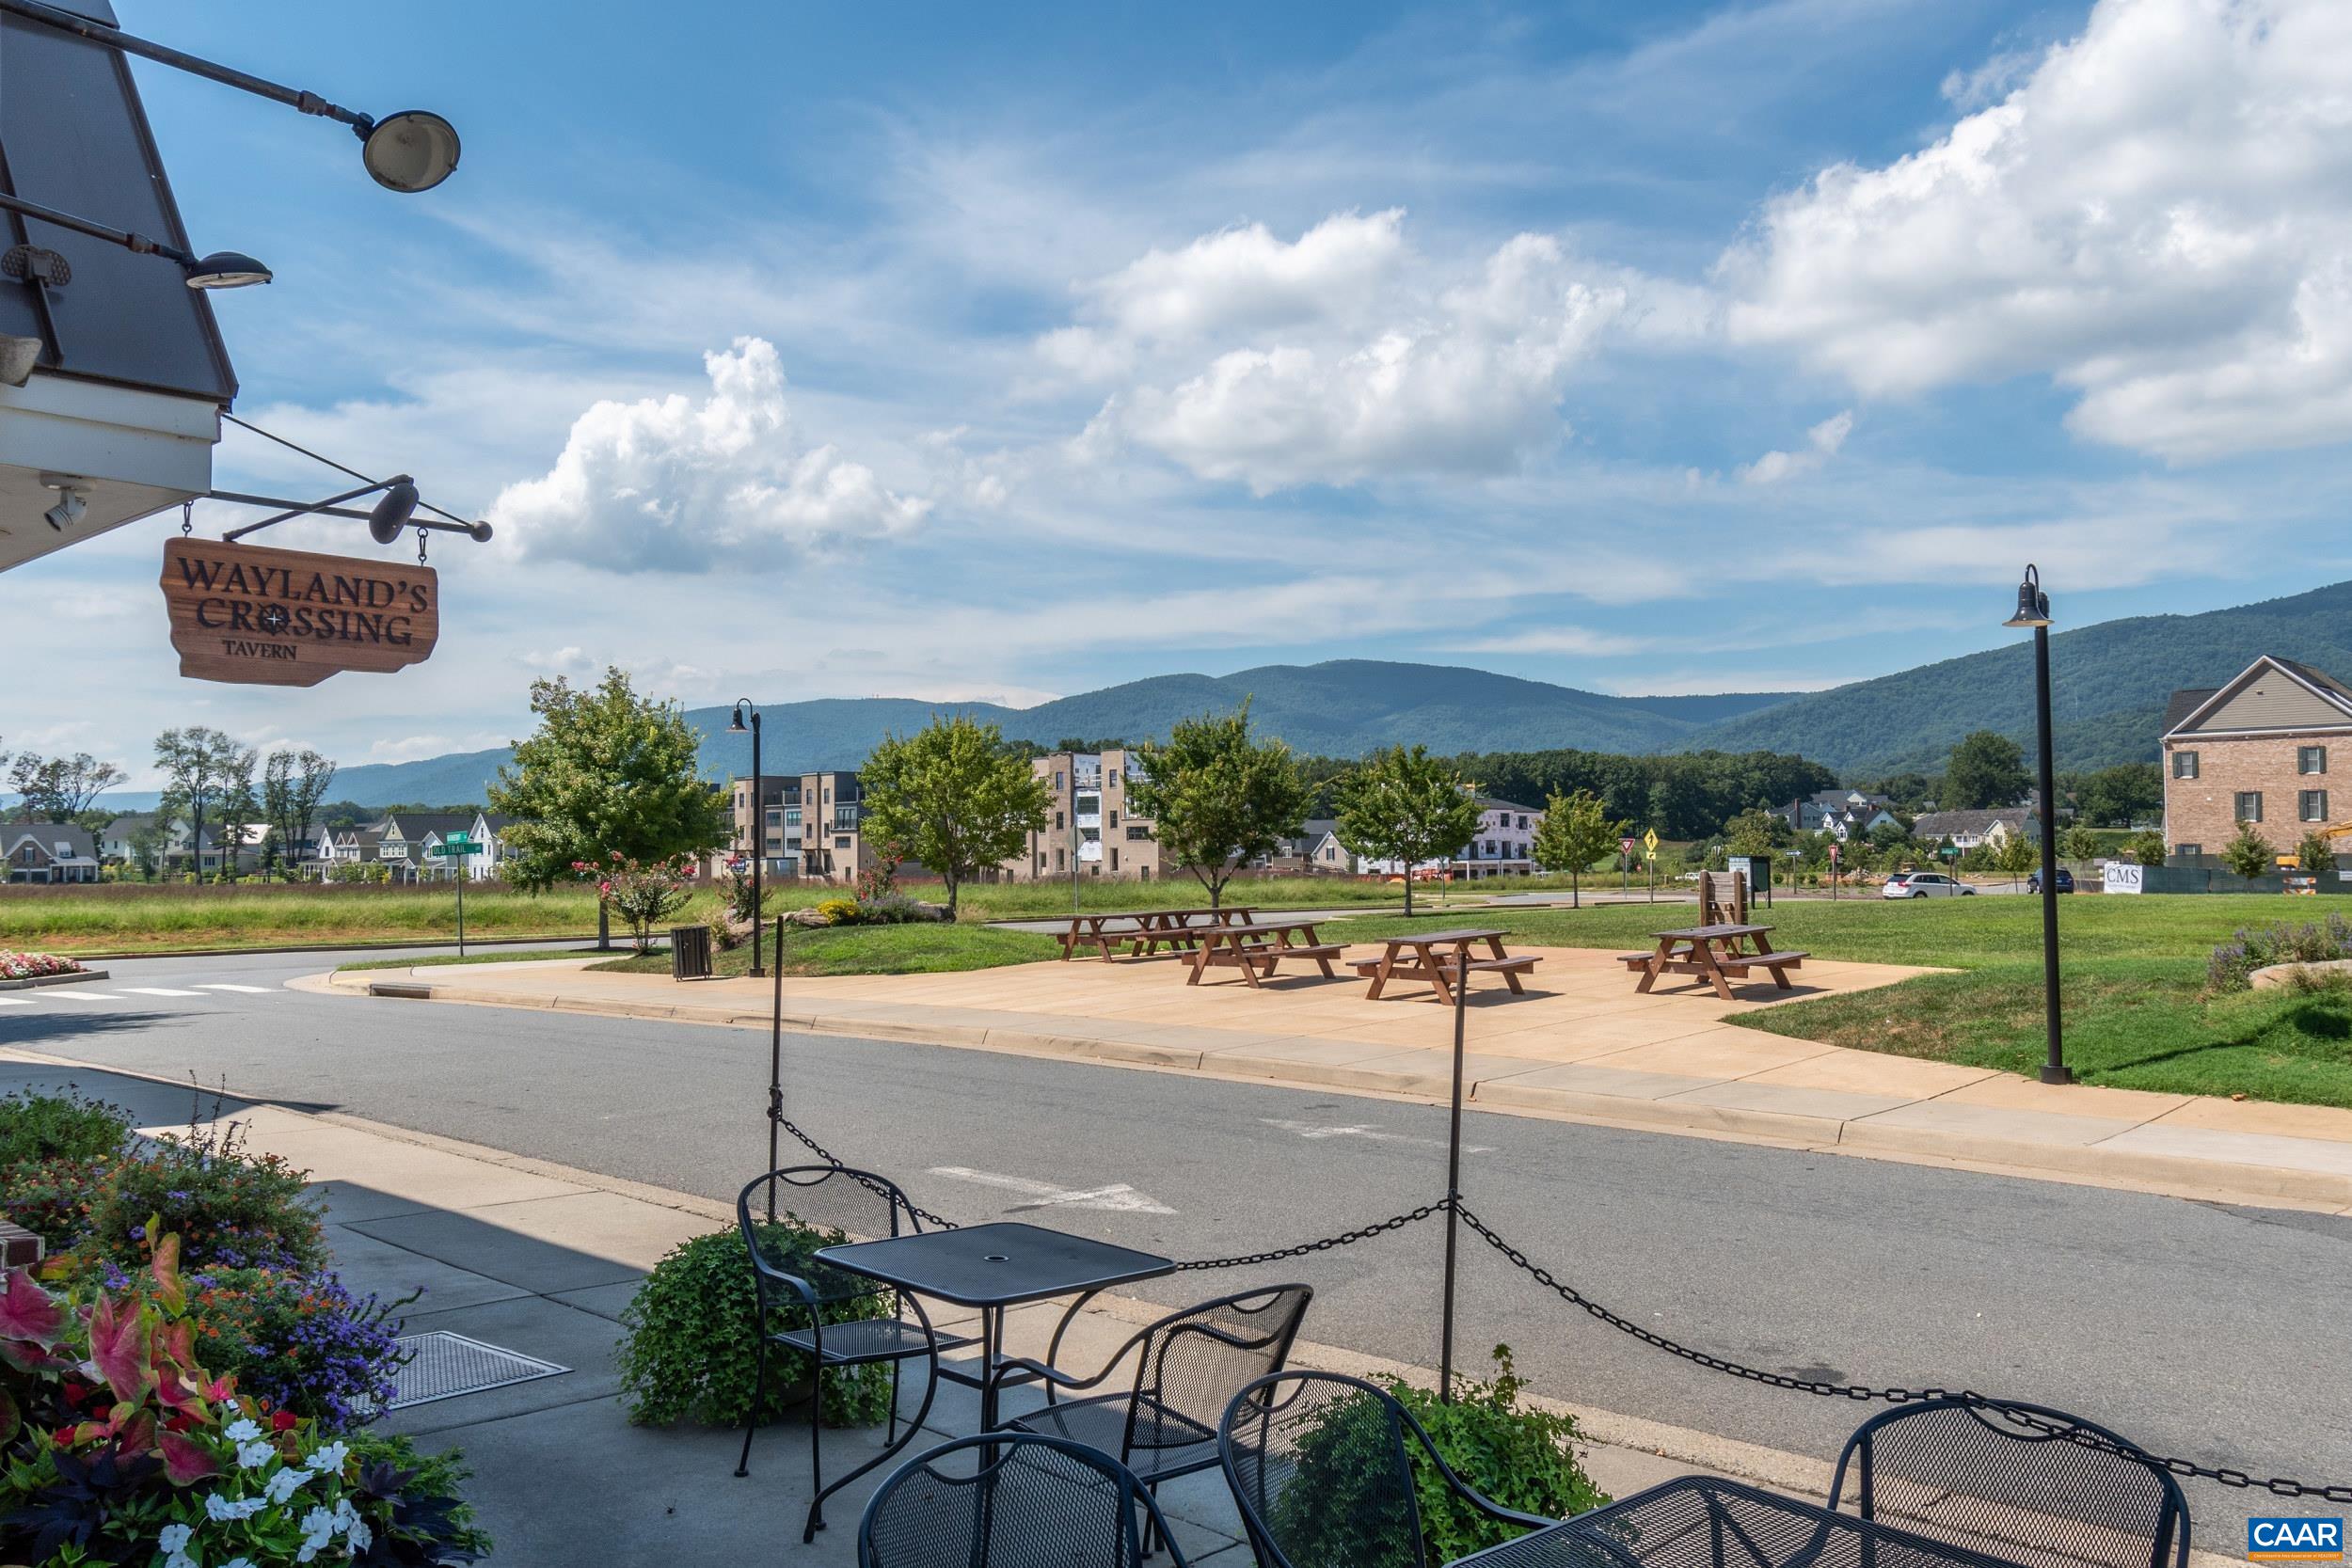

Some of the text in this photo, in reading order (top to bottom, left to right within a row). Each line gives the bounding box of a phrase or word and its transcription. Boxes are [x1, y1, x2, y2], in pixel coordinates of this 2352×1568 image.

[177, 557, 427, 613] WAYLAND'S
[196, 597, 412, 645] CROSSING
[222, 640, 297, 659] TAVERN
[433, 846, 446, 855] OLD
[448, 845, 467, 854] TRAIL
[2106, 868, 2139, 884] CMS
